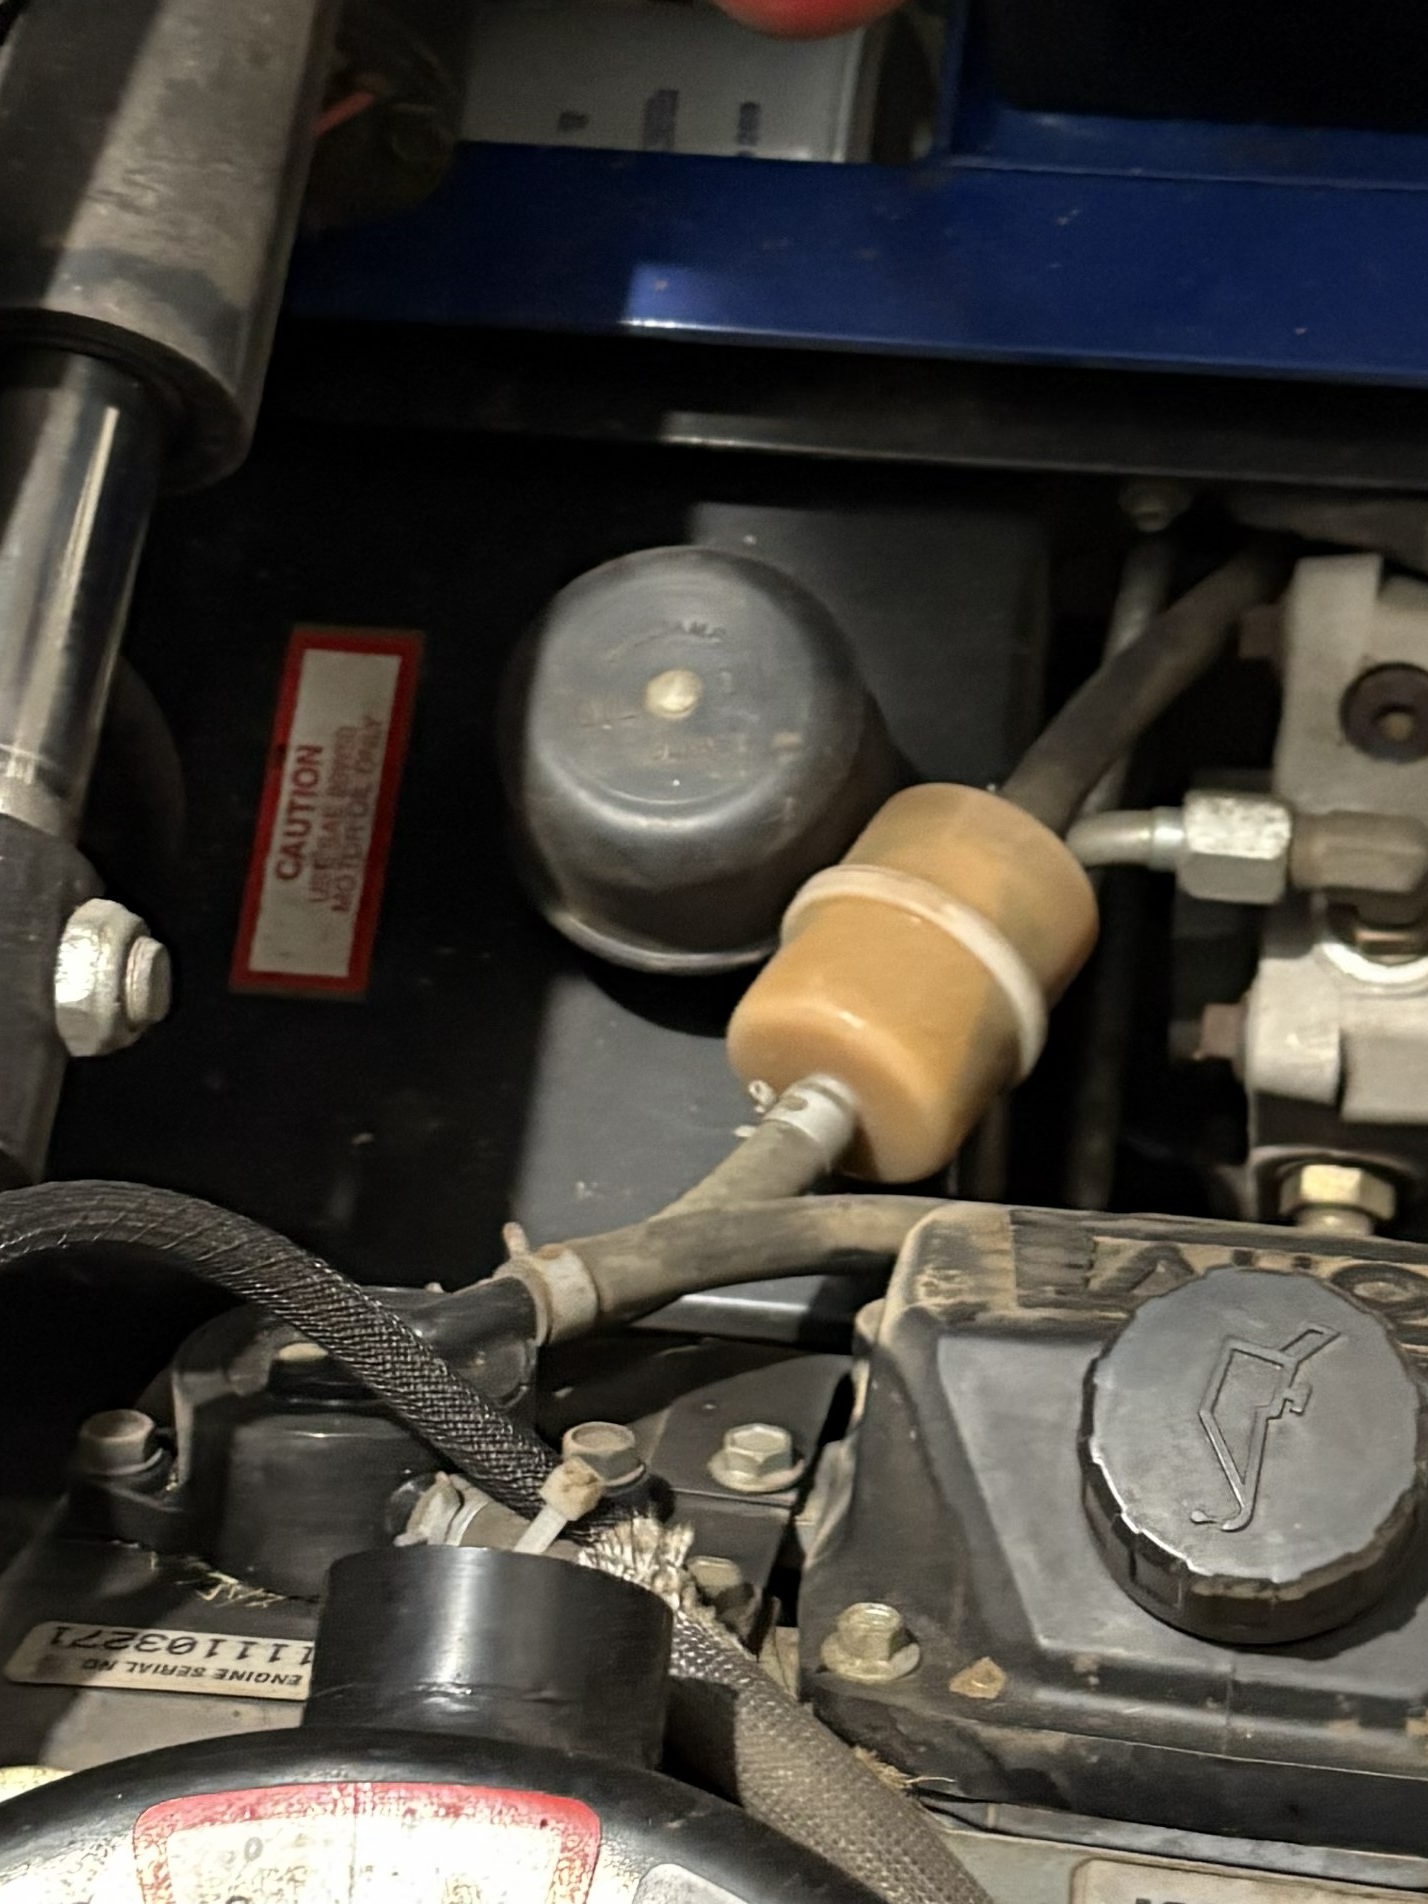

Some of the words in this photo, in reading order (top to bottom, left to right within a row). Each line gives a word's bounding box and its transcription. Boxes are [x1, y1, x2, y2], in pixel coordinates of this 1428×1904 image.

[275, 743, 323, 881] CAUTION
[125, 1661, 206, 1678] SERIAL
[214, 1667, 304, 1686] ENGINE
